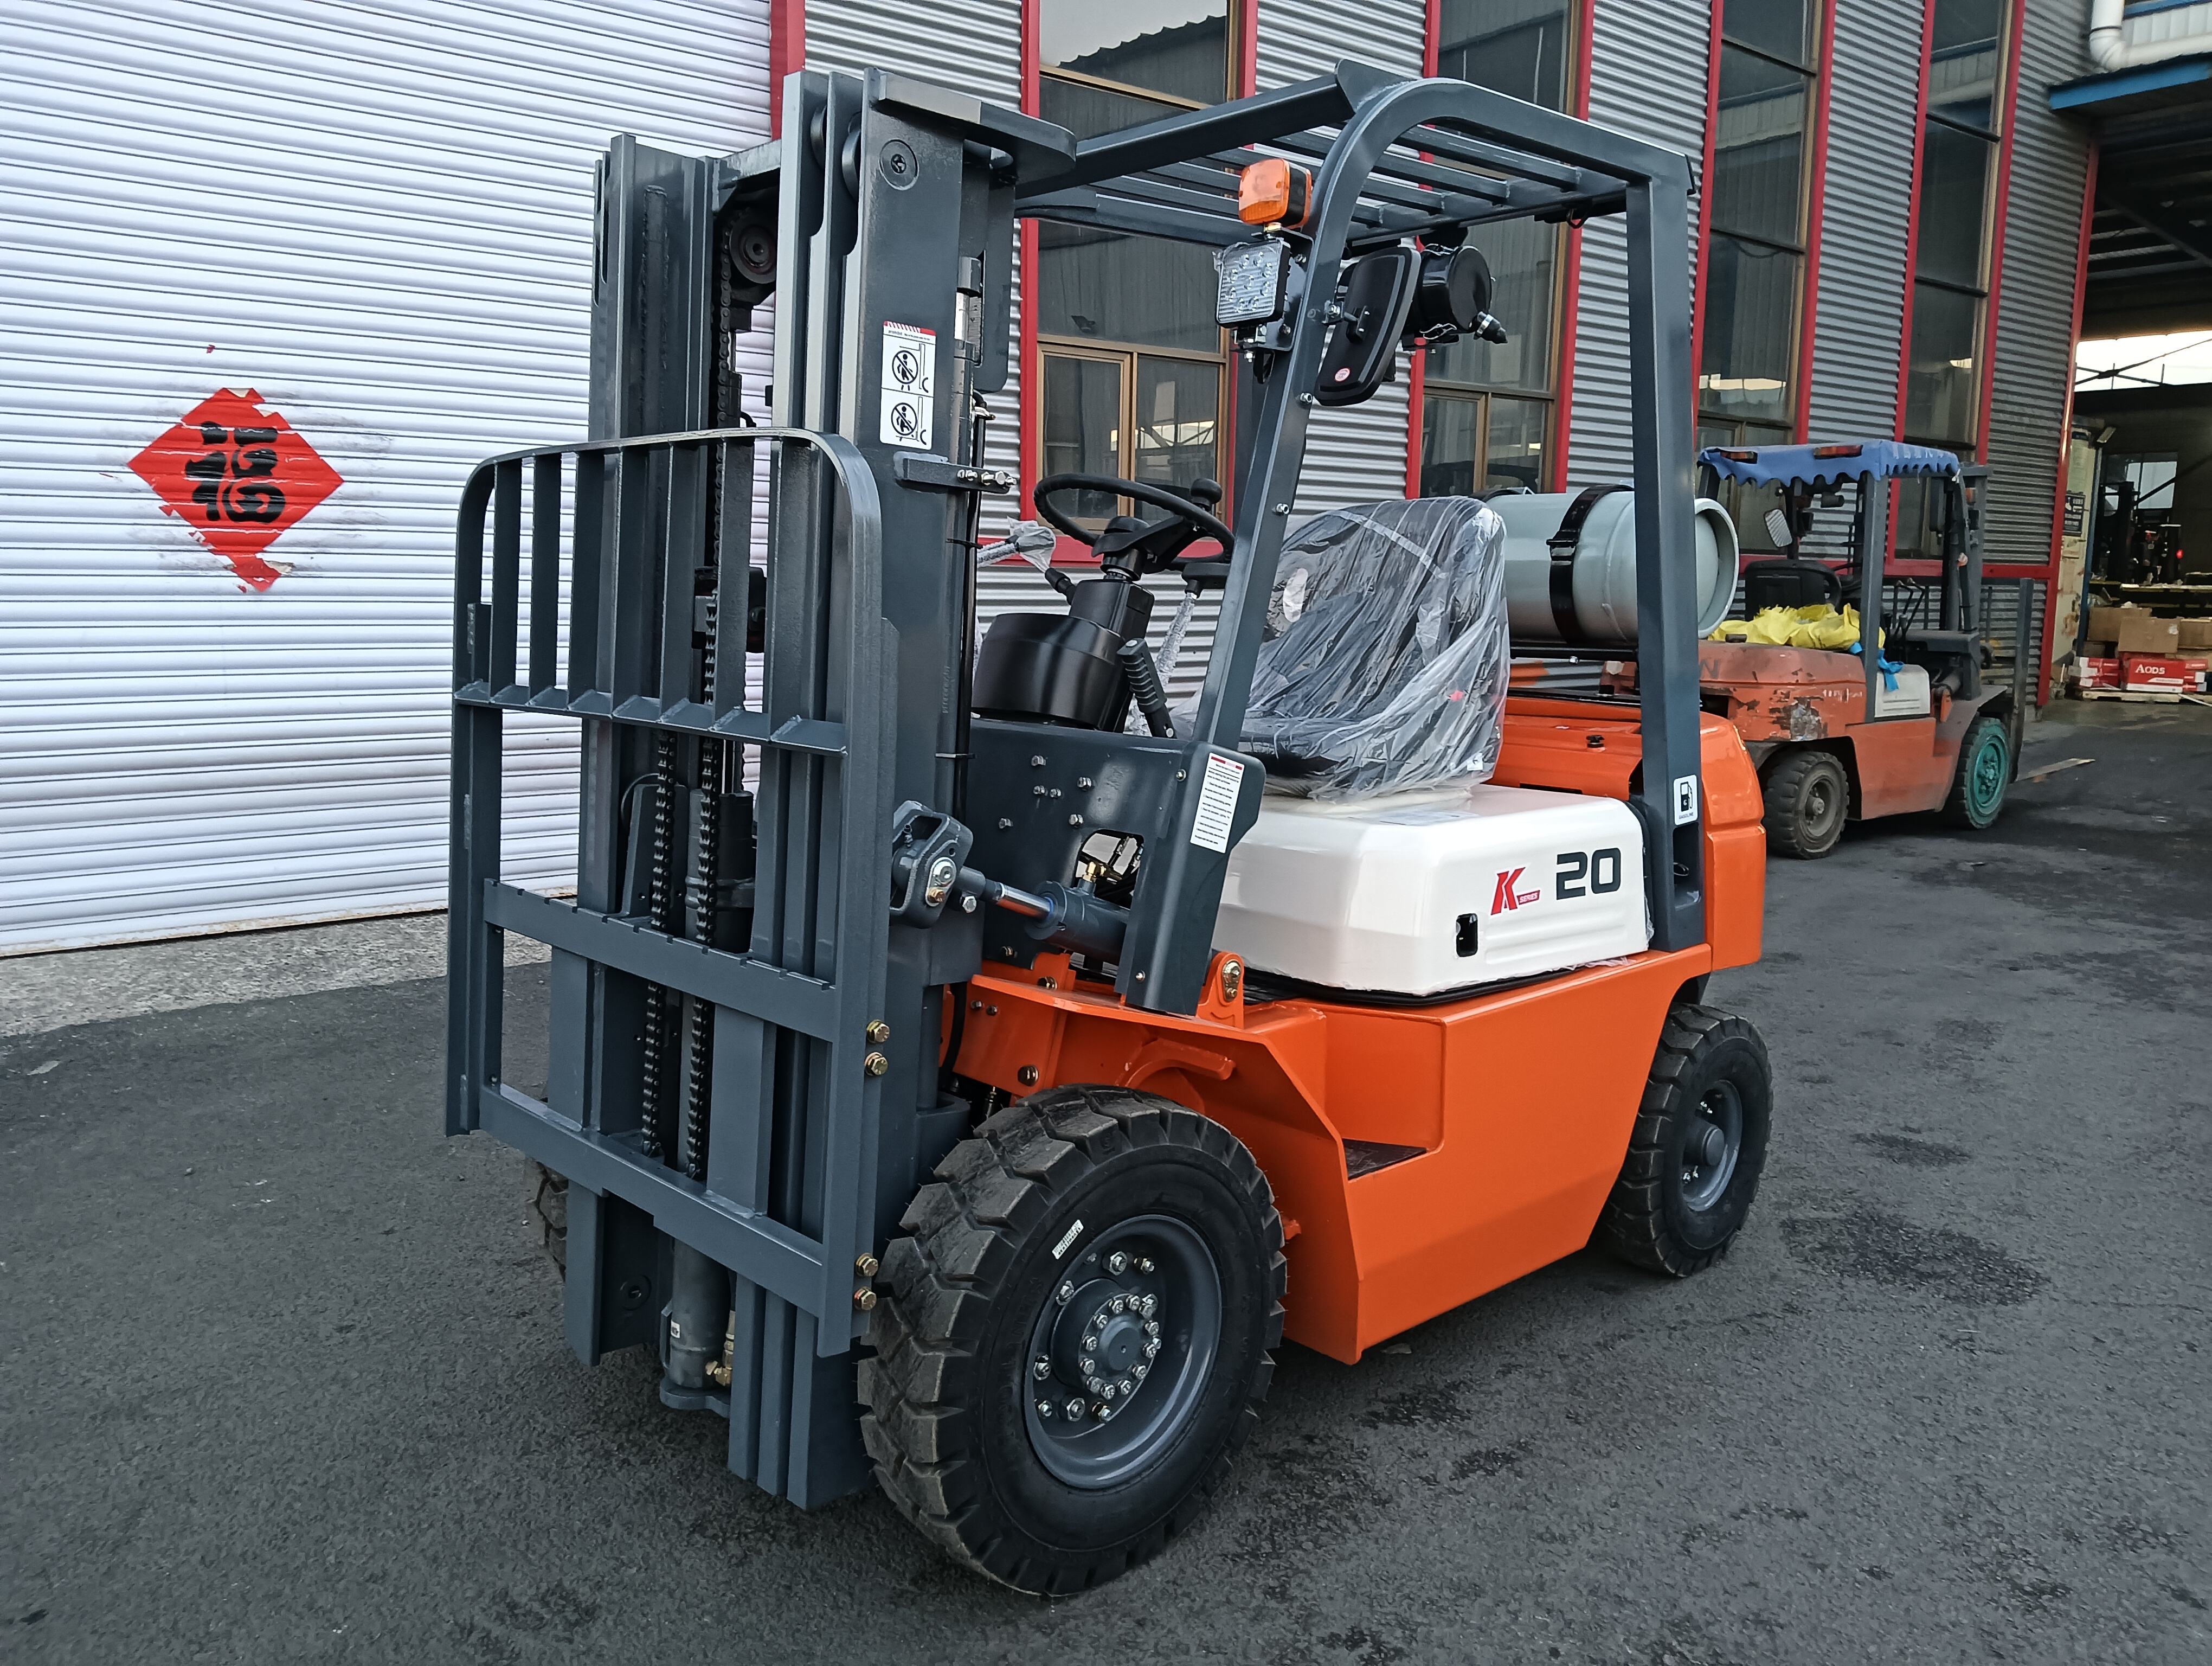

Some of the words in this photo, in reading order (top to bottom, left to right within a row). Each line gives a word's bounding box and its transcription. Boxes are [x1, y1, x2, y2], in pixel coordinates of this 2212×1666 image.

[185, 421, 286, 523] 福
[1679, 811, 1694, 819] GASOLINE
[1490, 867, 1526, 915] K
[1556, 847, 1622, 900] 20
